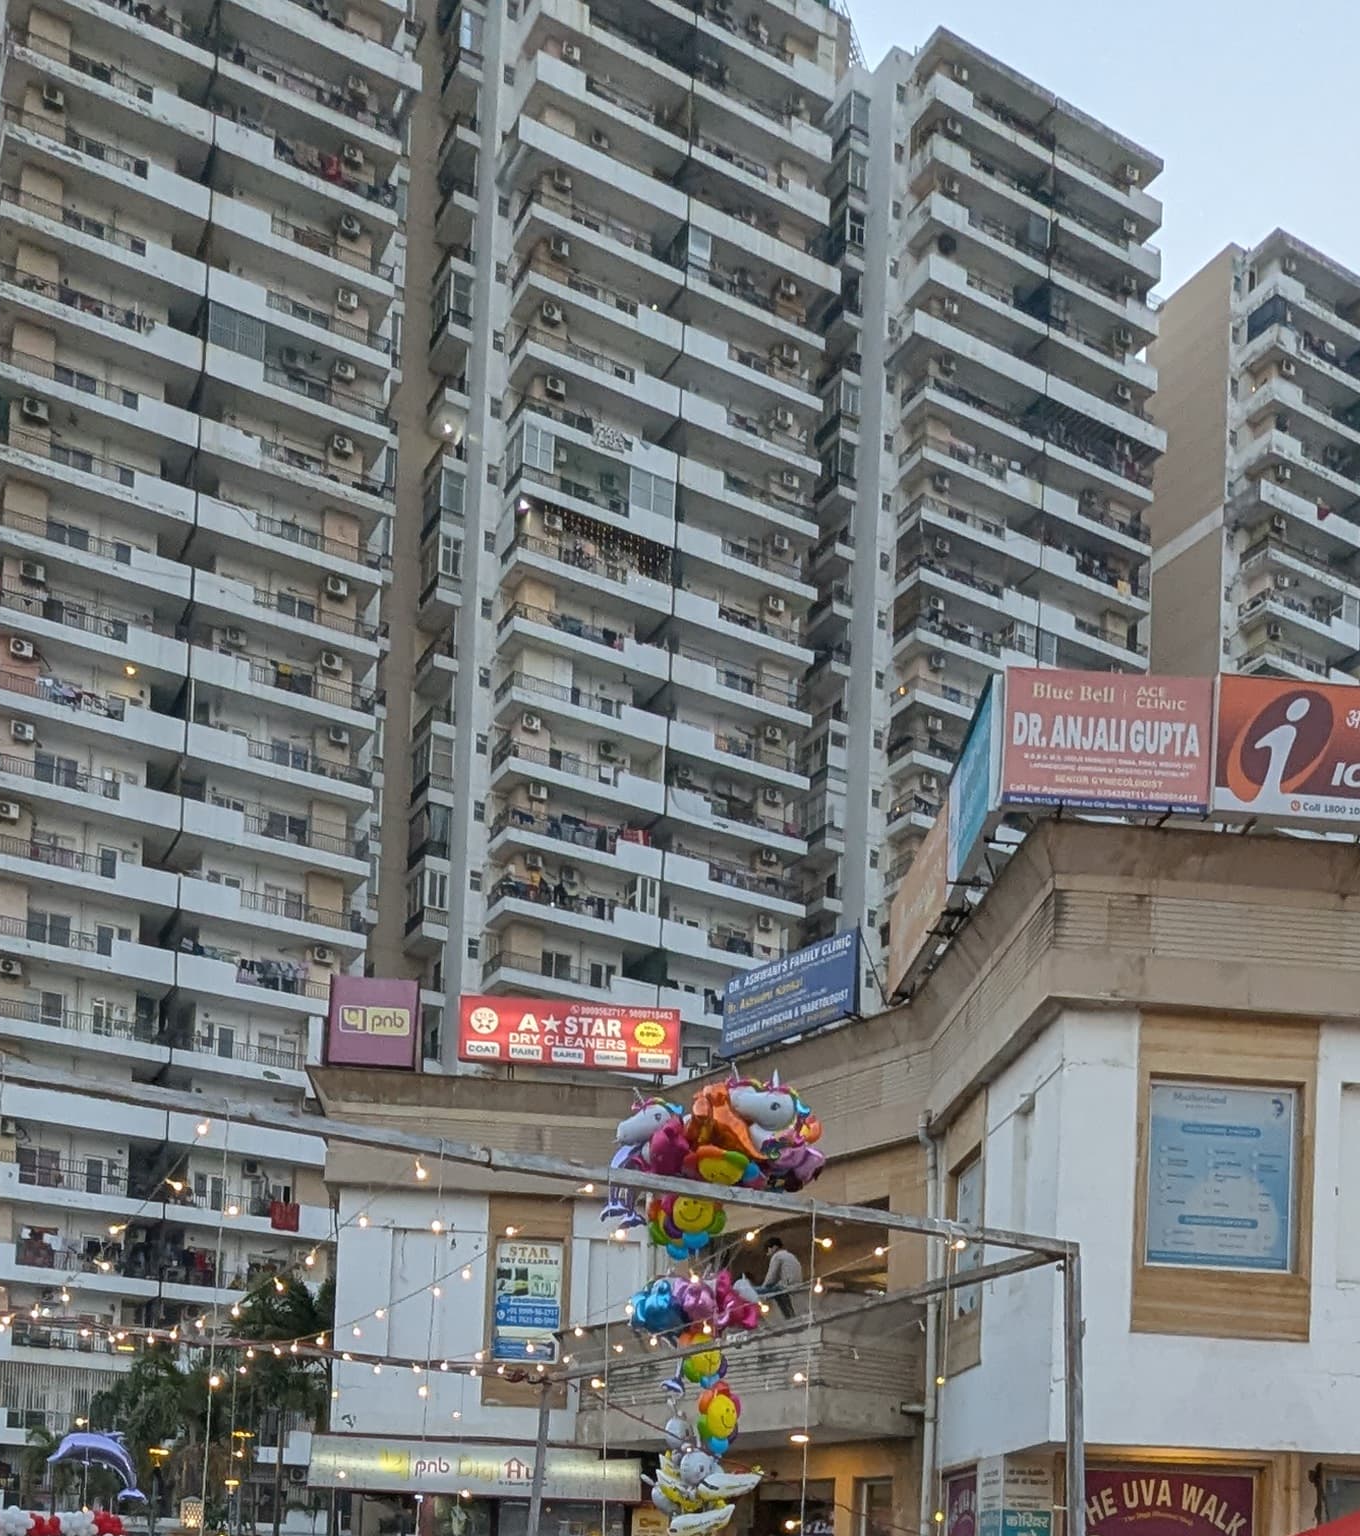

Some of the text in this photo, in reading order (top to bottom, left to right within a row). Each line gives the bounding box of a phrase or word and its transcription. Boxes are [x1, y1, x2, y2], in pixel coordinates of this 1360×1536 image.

[1032, 683, 1115, 702] Blue Bell
[1137, 686, 1165, 697] ACE
[1136, 699, 1187, 711] CLINIC
[1013, 712, 1200, 757] DR. ANJALI GUPTA
[1303, 803, 1321, 812] Call
[1324, 804, 1346, 814] 1800
[821, 934, 852, 956] CLINIC
[371, 1013, 405, 1029] pnb
[518, 1013, 539, 1032] A
[564, 1016, 622, 1038] STAR
[468, 1045, 496, 1053] COAT
[509, 1033, 540, 1044] DRY
[544, 1035, 626, 1051] CLEANERS
[509, 1246, 549, 1258] STAR
[415, 1456, 450, 1479] pnb
[1085, 1487, 1118, 1526] HE
[1122, 1479, 1172, 1508] UVA
